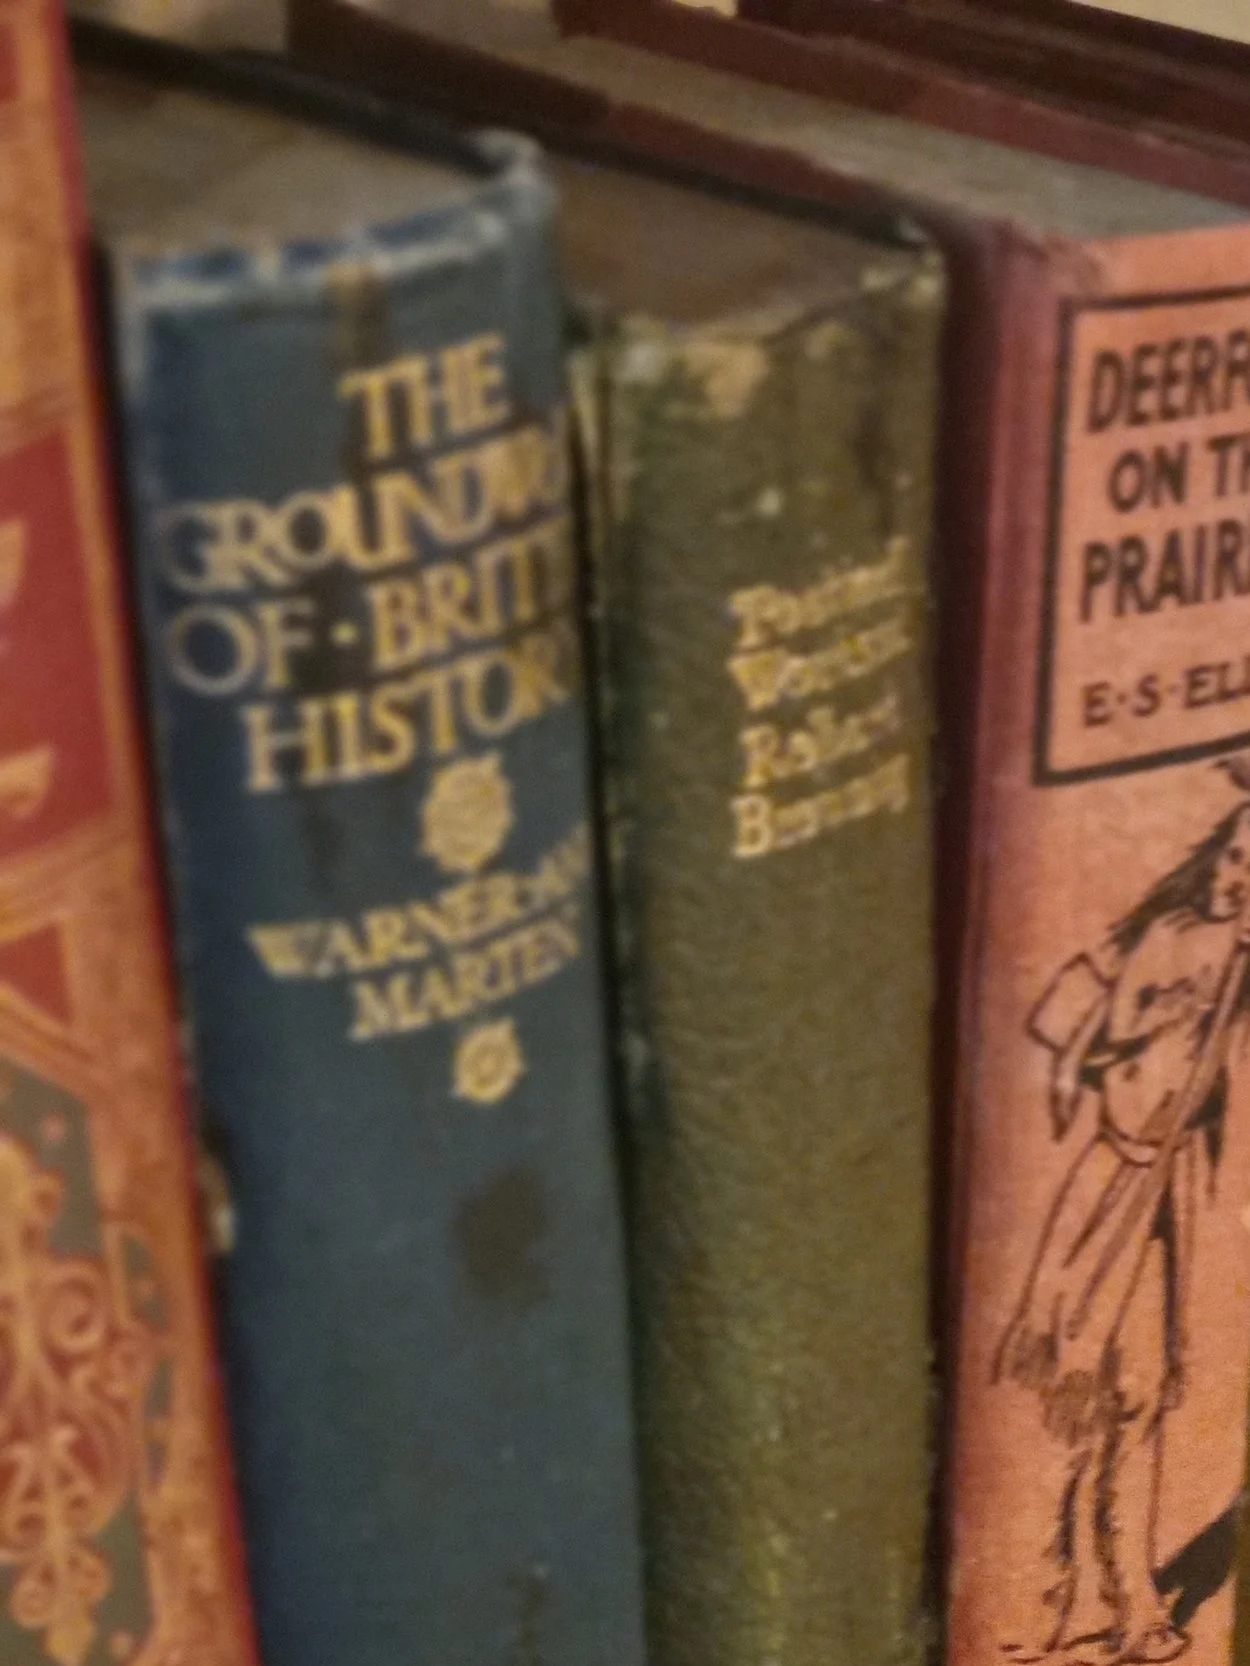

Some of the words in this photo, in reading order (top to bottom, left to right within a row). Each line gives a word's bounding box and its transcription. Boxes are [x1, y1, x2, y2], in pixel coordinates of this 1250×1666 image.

[339, 332, 507, 460] THE
[1107, 437, 1190, 513] ON
[169, 601, 317, 696] OF
